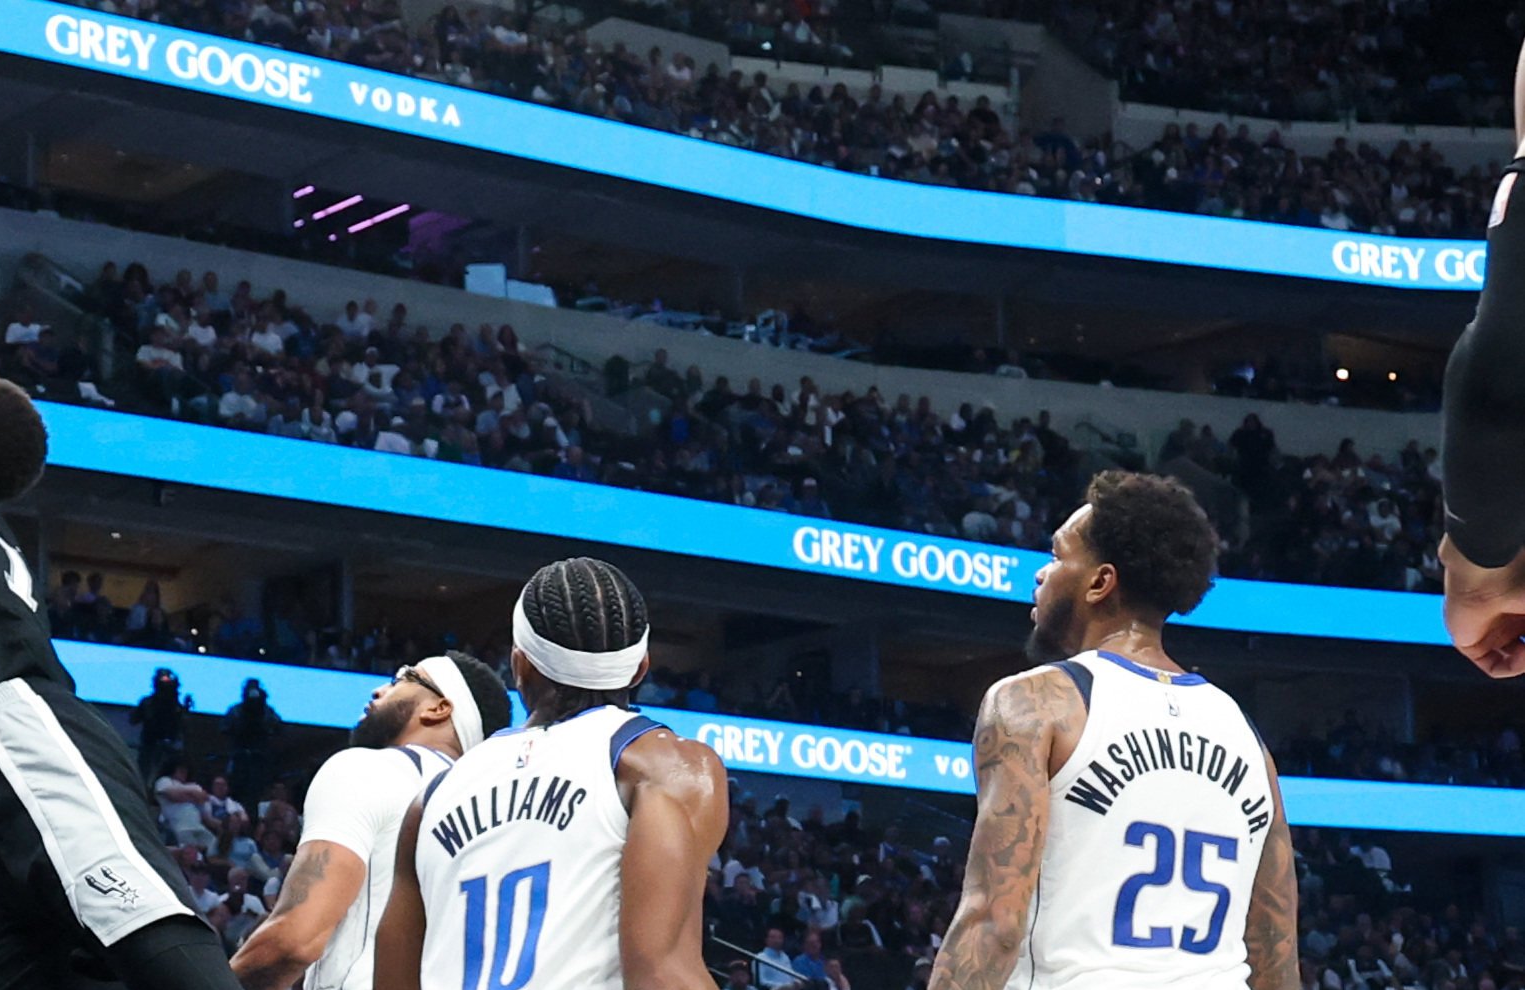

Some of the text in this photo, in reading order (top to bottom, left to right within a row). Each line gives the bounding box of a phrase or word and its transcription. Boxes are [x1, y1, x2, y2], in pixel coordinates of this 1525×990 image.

[45, 13, 461, 128] GREY GOOSE VODKA
[1332, 240, 1425, 281] GREY
[792, 526, 1012, 592] GREY GOOSE
[697, 723, 784, 765] GREY
[791, 733, 907, 779] GOOSE
[1065, 728, 1249, 816] WASHINGTON
[431, 776, 587, 858] WILLIAMS
[1112, 820, 1239, 956] 25
